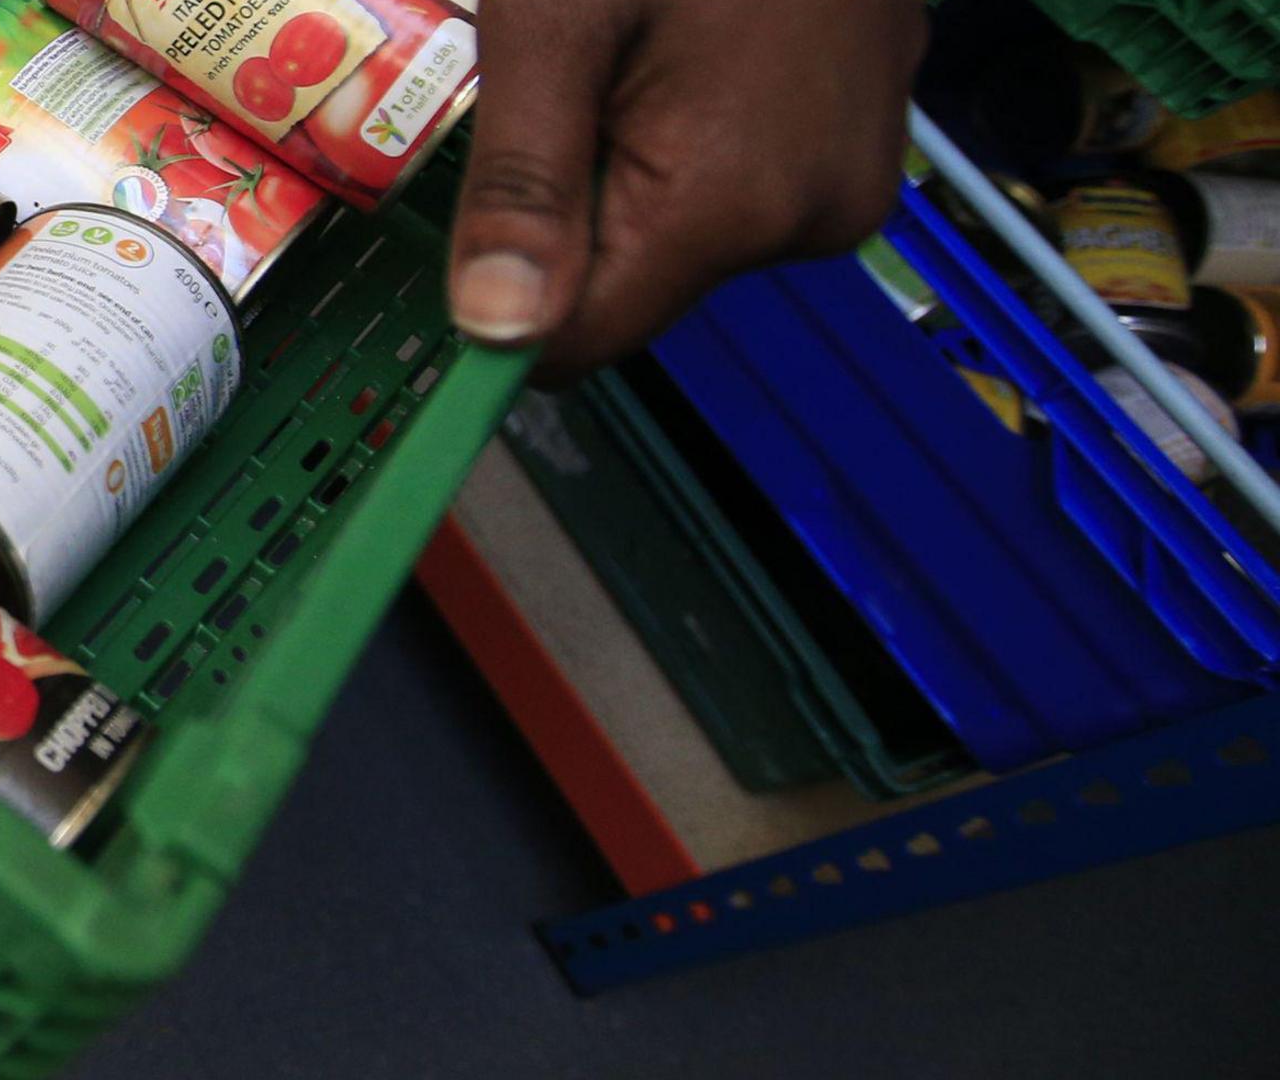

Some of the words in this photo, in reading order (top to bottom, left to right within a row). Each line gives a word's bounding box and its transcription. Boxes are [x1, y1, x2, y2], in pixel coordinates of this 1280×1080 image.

[165, 1, 226, 64] PEELED
[213, 54, 232, 74] rich
[229, 17, 270, 56] tomato
[402, 86, 417, 105] of
[424, 66, 436, 77] a
[432, 40, 457, 65] day
[31, 252, 71, 270] tomato
[71, 263, 98, 279] juice
[63, 251, 92, 270] plum
[92, 260, 141, 296] tomatoes
[173, 267, 204, 304] 400g
[46, 268, 78, 285] before
[113, 300, 132, 318] end
